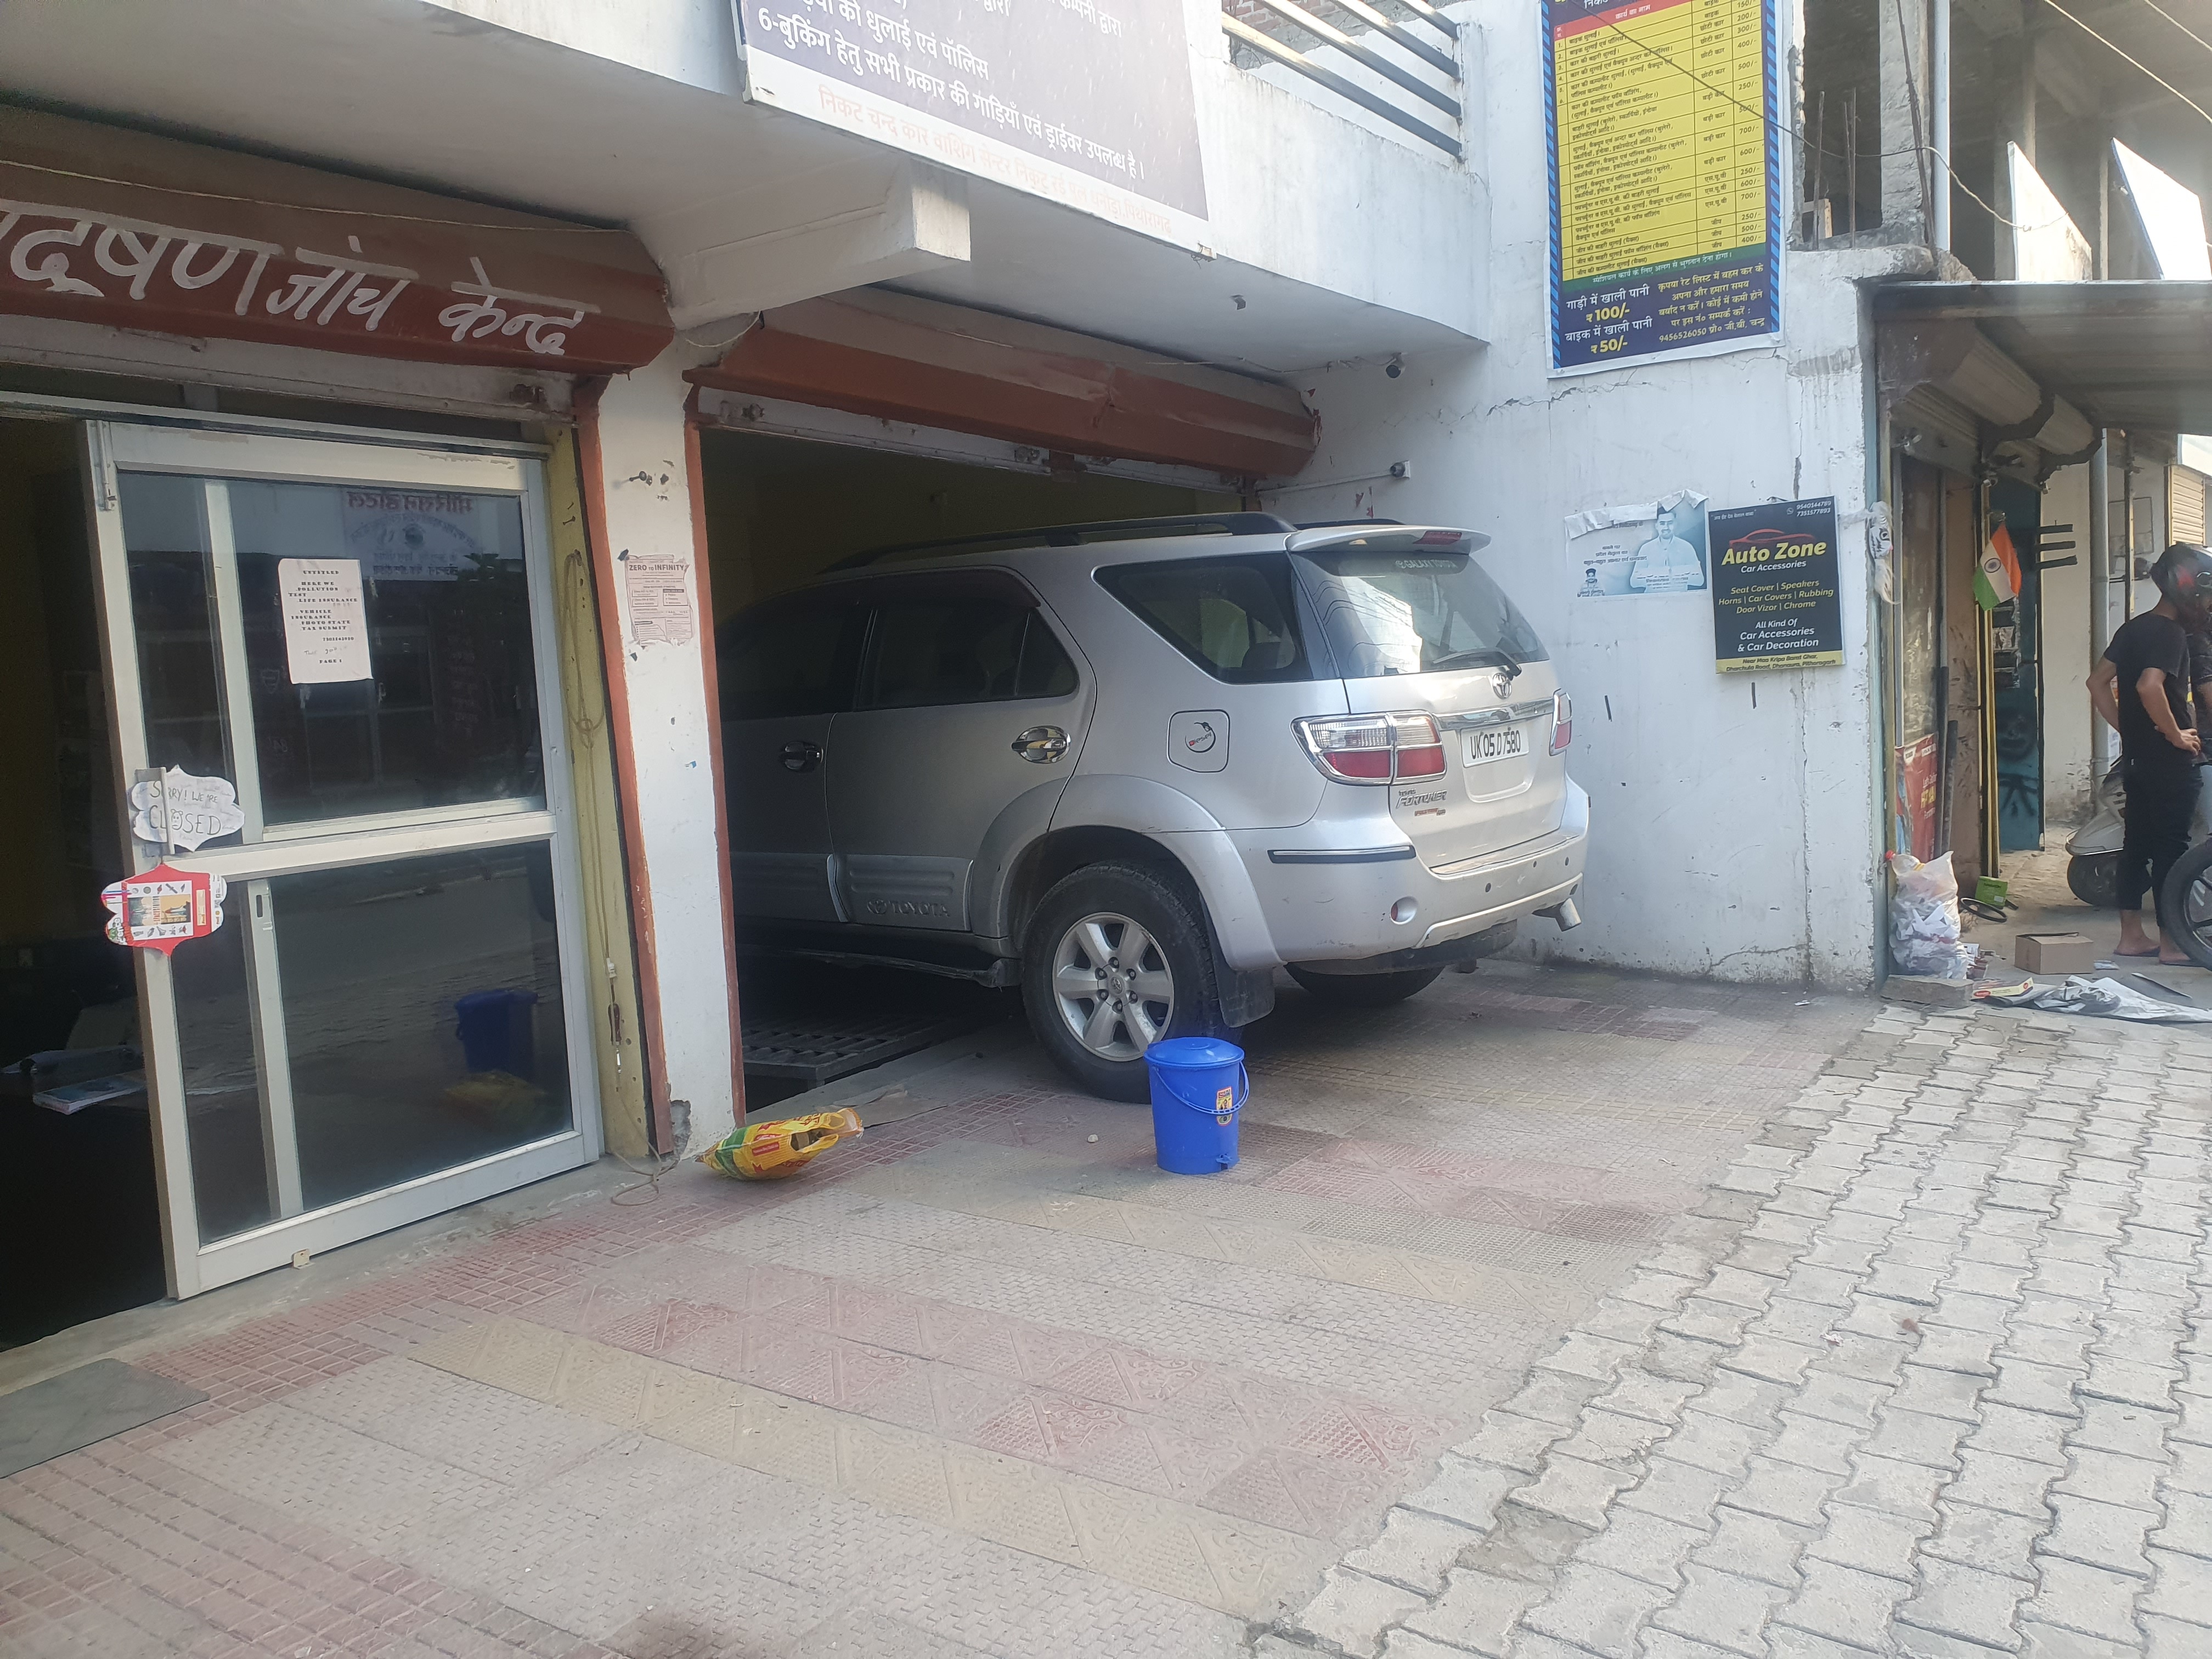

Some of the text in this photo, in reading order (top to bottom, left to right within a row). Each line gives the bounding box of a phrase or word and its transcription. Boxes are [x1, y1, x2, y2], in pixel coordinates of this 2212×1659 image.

[1639, 4, 1650, 13] नाम
[1737, 10, 1756, 21] 200/-
[1098, 10, 1121, 37] द्वारा
[1737, 22, 1756, 33] 300/-
[866, 10, 911, 51] धुलाई
[914, 32, 938, 58] एवं
[940, 37, 989, 80] पॉलिस
[1737, 38, 1757, 48] 400/-
[1738, 59, 1757, 70] 500/-
[758, 8, 831, 55] 6-बुकिंग
[834, 29, 864, 76] हेतु
[864, 49, 901, 82] सभी
[904, 65, 945, 100] प्रकार
[949, 80, 970, 110] की
[973, 90, 1020, 129] गाड़ियाँ
[1022, 115, 1042, 138] एवं
[1045, 122, 1082, 154] ड्राईवर
[1085, 139, 1126, 172] उपलब्ध
[1738, 80, 1758, 91] 250/-
[819, 84, 863, 121] निकट
[901, 119, 930, 145] कार
[1740, 124, 1759, 134] 700/-
[1740, 146, 1759, 156] 600/-
[1740, 165, 1760, 175] 250/-
[1741, 177, 1760, 187] 600/-
[1741, 190, 1760, 200] 700/-
[1741, 211, 1760, 221] 250/-
[1741, 222, 1761, 233] 500/-
[1741, 234, 1762, 244] 400/-
[0, 200, 283, 315] दूषण
[1655, 263, 1671, 272] अलग
[1680, 257, 1700, 269] भुगतान
[1658, 280, 1678, 292] कृपया
[1680, 278, 1690, 286] रेट
[1692, 274, 1712, 284] लिस्ट
[1755, 263, 1763, 272] के
[1566, 295, 1587, 310] गाड़ी
[1601, 288, 1626, 303] खाली
[1629, 283, 1650, 297] पानी
[1672, 280, 1749, 301] अपना और हमारा समय
[1706, 298, 1722, 307] कोई
[1732, 293, 1747, 302] कमी
[1750, 290, 1763, 300] होने
[1671, 318, 1680, 326] पर
[1683, 317, 1692, 326] इस
[1708, 308, 1731, 320] सम्पर्क
[1733, 306, 1745, 316] करें
[1565, 315, 1652, 342] बाइक में खाली पानी
[1659, 328, 1706, 342] 9456526050
[1750, 317, 1765, 326] चन्द्र
[1722, 541, 1827, 565] Auto Zone
[1740, 560, 1807, 573] Car Accessories
[1751, 584, 1775, 592] Cover
[1780, 579, 1819, 590] Speakers
[1718, 596, 1741, 605] Horns
[1763, 592, 1792, 601] Covers
[1798, 588, 1833, 599] Rubbing
[1757, 603, 1778, 612] Vizor
[1784, 600, 1816, 610] Chrome
[1740, 627, 1815, 640] Car Accessories
[1746, 642, 1763, 651] Car
[1766, 638, 1819, 650] Decoration
[889, 900, 950, 917] TOYOTA
